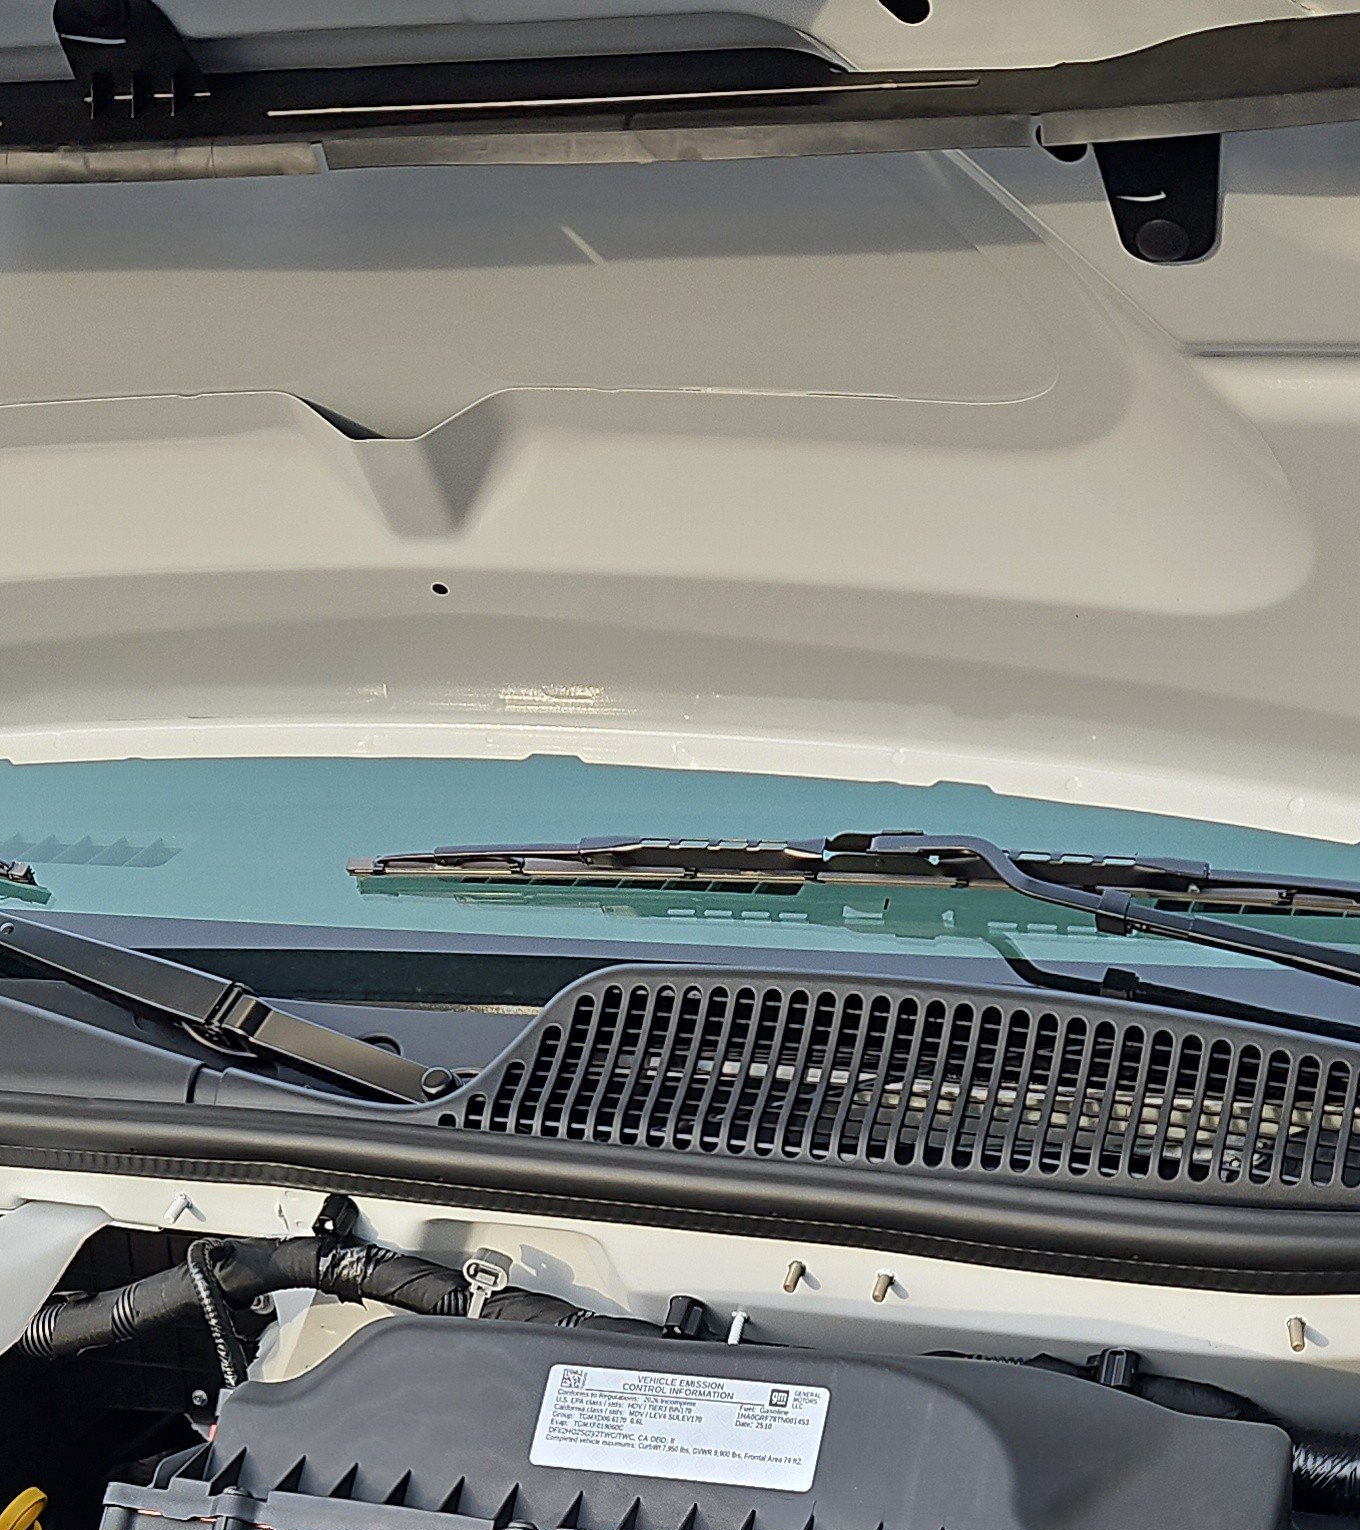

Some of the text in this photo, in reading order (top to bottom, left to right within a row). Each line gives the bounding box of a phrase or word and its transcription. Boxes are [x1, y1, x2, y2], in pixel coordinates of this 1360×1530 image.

[637, 1375, 724, 1390] VEHICLE EMISSION
[622, 1383, 734, 1399] CONTROL INFORMATION
[770, 1391, 788, 1406] gm
[794, 1390, 820, 1398] GENERAL
[759, 1407, 788, 1415] Gasoline
